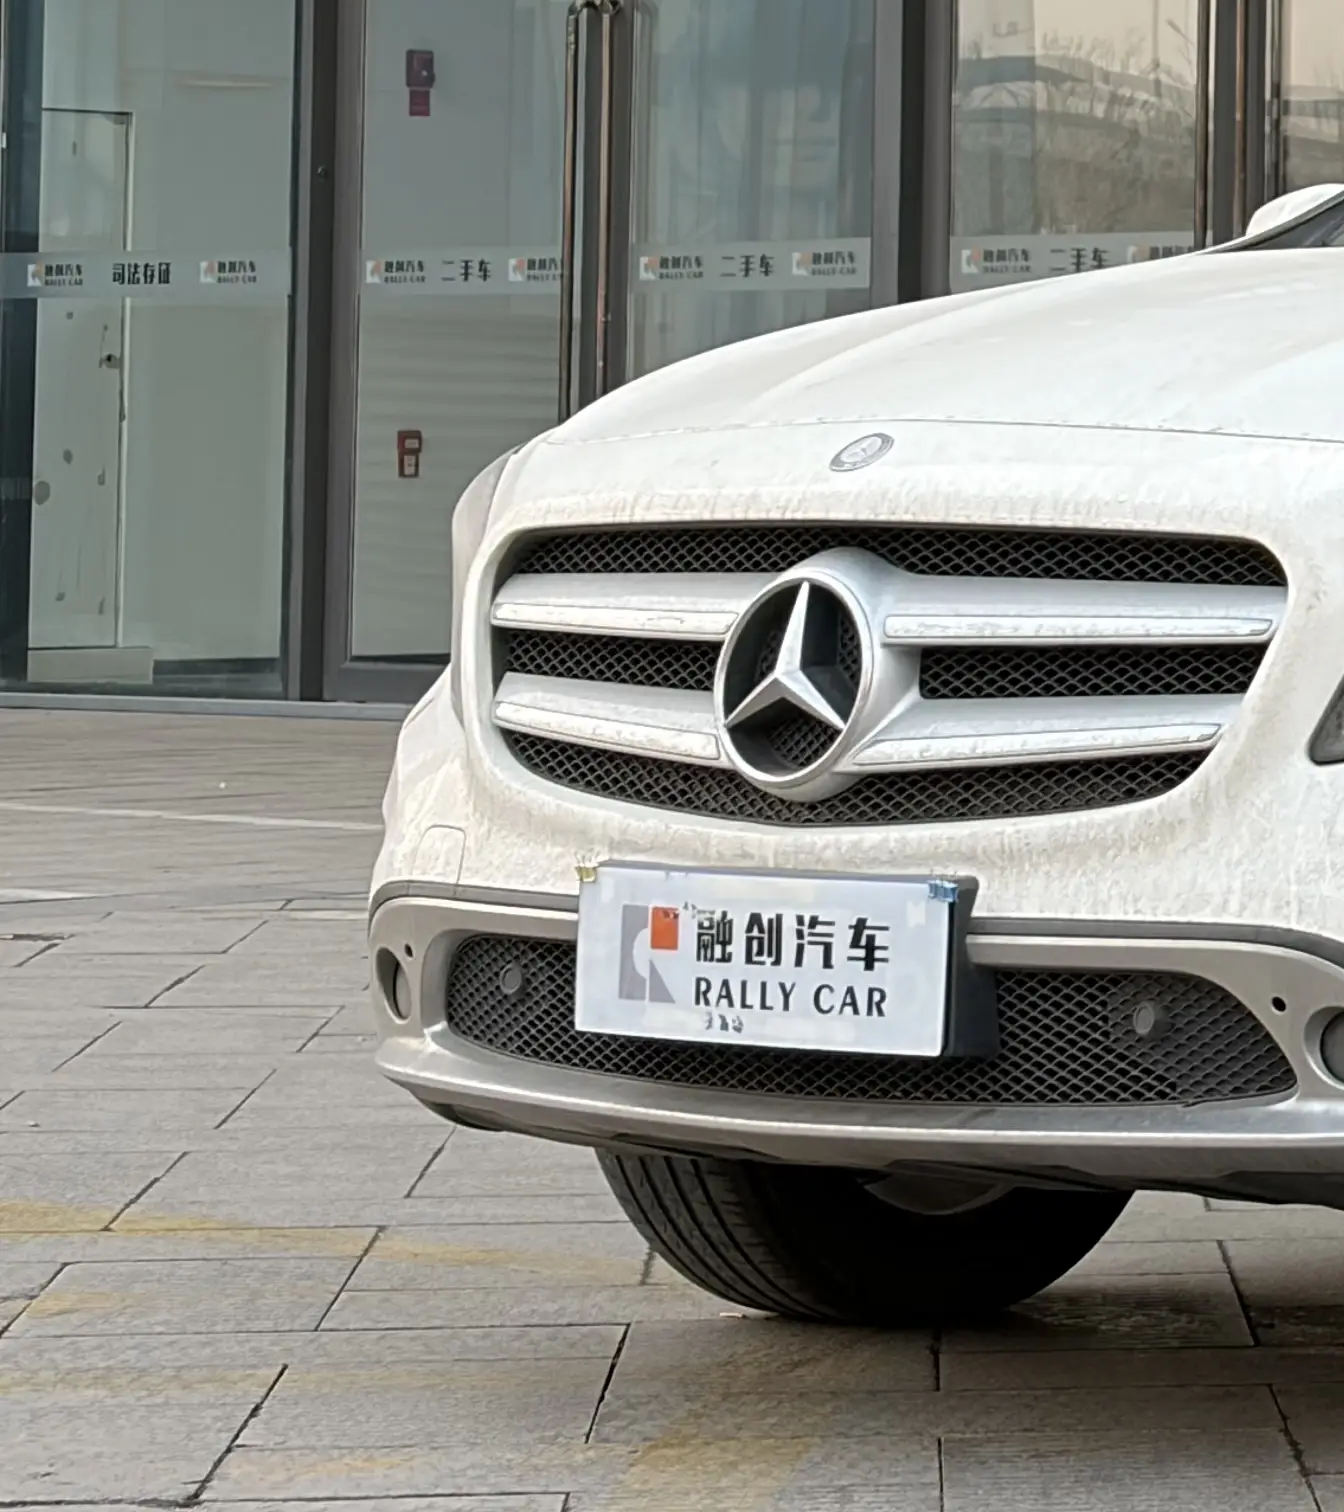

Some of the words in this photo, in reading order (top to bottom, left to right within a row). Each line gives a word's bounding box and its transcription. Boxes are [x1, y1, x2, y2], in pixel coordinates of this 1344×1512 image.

[441, 259, 492, 282] 二手车
[720, 254, 776, 278] 二手车
[1049, 247, 1110, 273] 二手车
[112, 262, 172, 285] 司法存证
[696, 909, 890, 972] 融创汽车
[694, 976, 797, 1012] RALLY
[812, 983, 888, 1018] CAR
